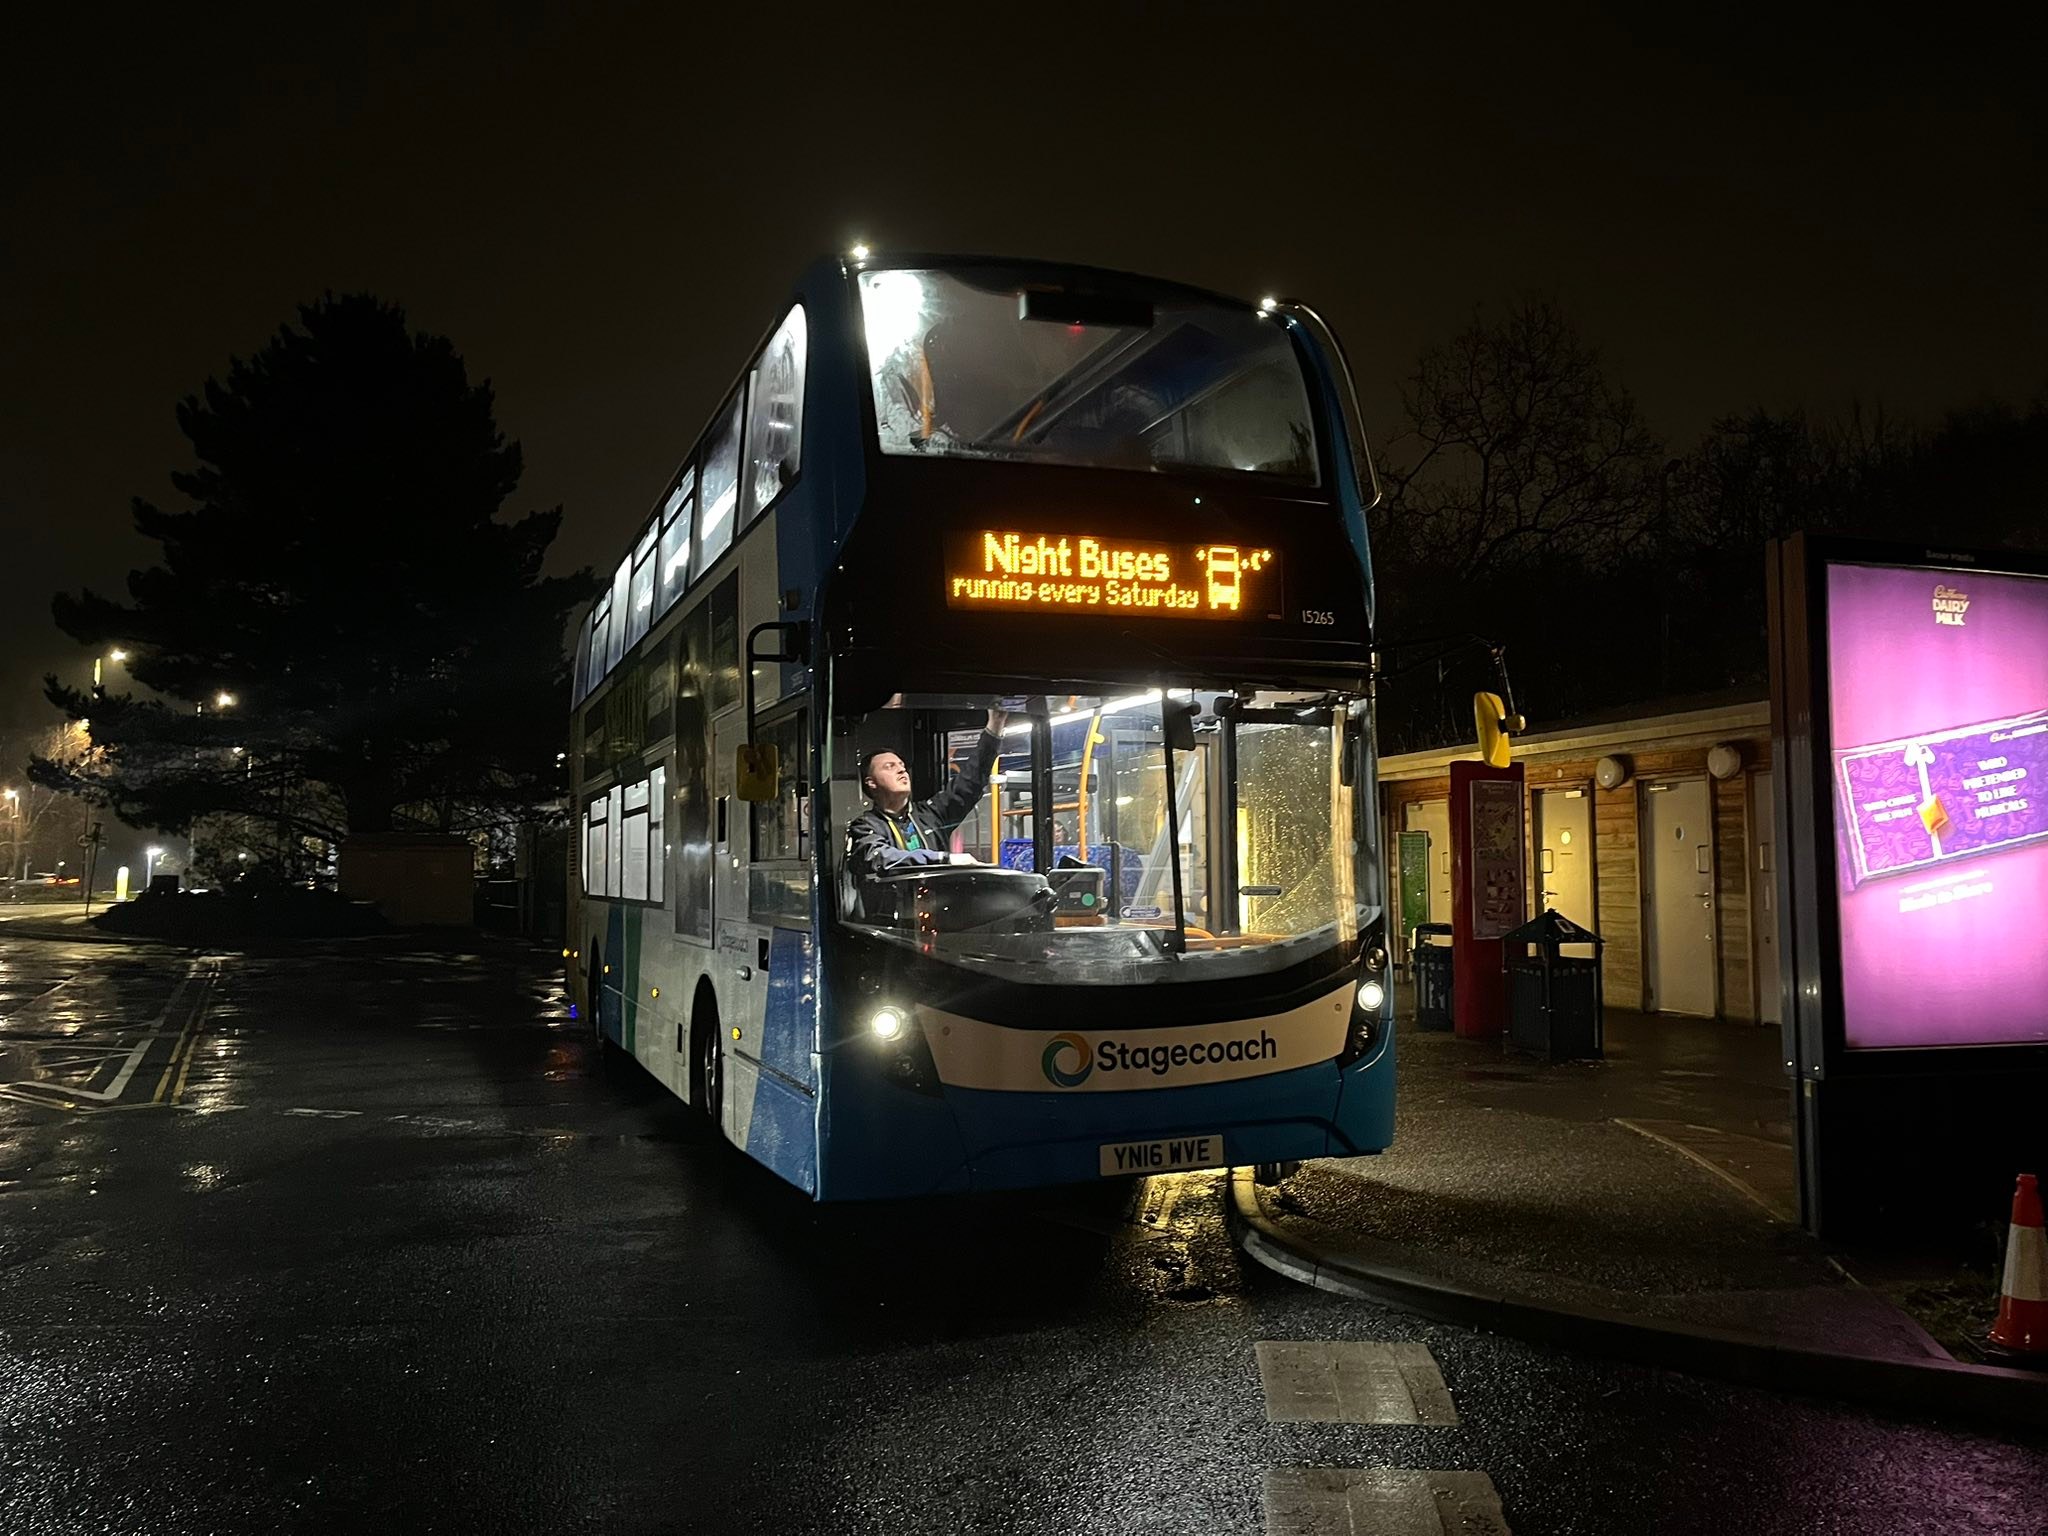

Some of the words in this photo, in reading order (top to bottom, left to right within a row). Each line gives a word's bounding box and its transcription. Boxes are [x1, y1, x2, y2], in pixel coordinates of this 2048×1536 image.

[984, 533, 1072, 577] Night
[1079, 540, 1170, 582] Buses
[952, 574, 1034, 601] running
[1037, 583, 1101, 604] every
[1105, 580, 1199, 609] Saturday
[1302, 609, 1335, 625] 15265
[1932, 598, 1970, 613] DAIRY
[1935, 611, 1966, 626] MILK
[1975, 790, 1993, 802] TO
[1097, 1029, 1277, 1076] Stagecoach
[1114, 1143, 1163, 1170] YN16
[1169, 1138, 1210, 1164] WVE
